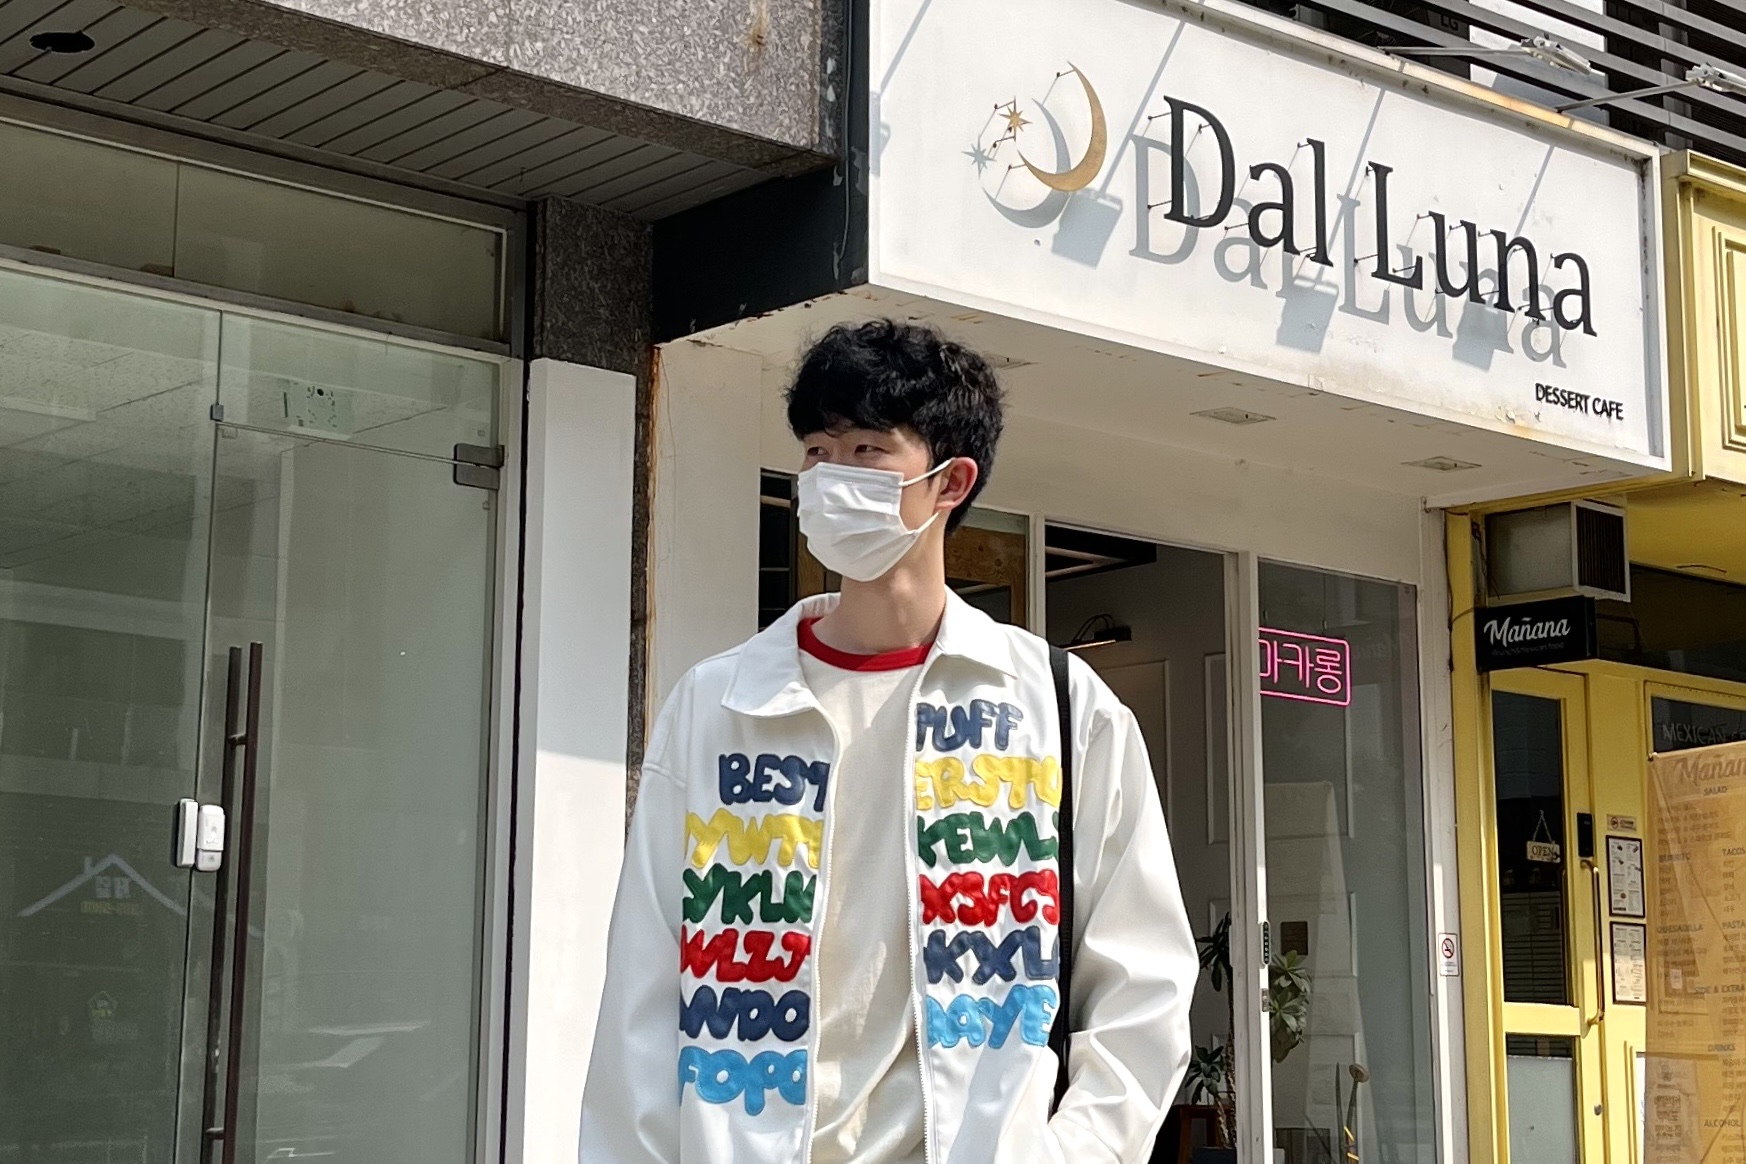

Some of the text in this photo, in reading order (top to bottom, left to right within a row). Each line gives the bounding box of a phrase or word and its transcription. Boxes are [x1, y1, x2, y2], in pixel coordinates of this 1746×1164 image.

[1440, 15, 1459, 31] LG
[1164, 95, 1598, 338] Dal Luna
[1535, 382, 1624, 421] DESSERT CAFE
[1484, 616, 1571, 648] Mañana
[1532, 845, 1554, 857] OPEN
